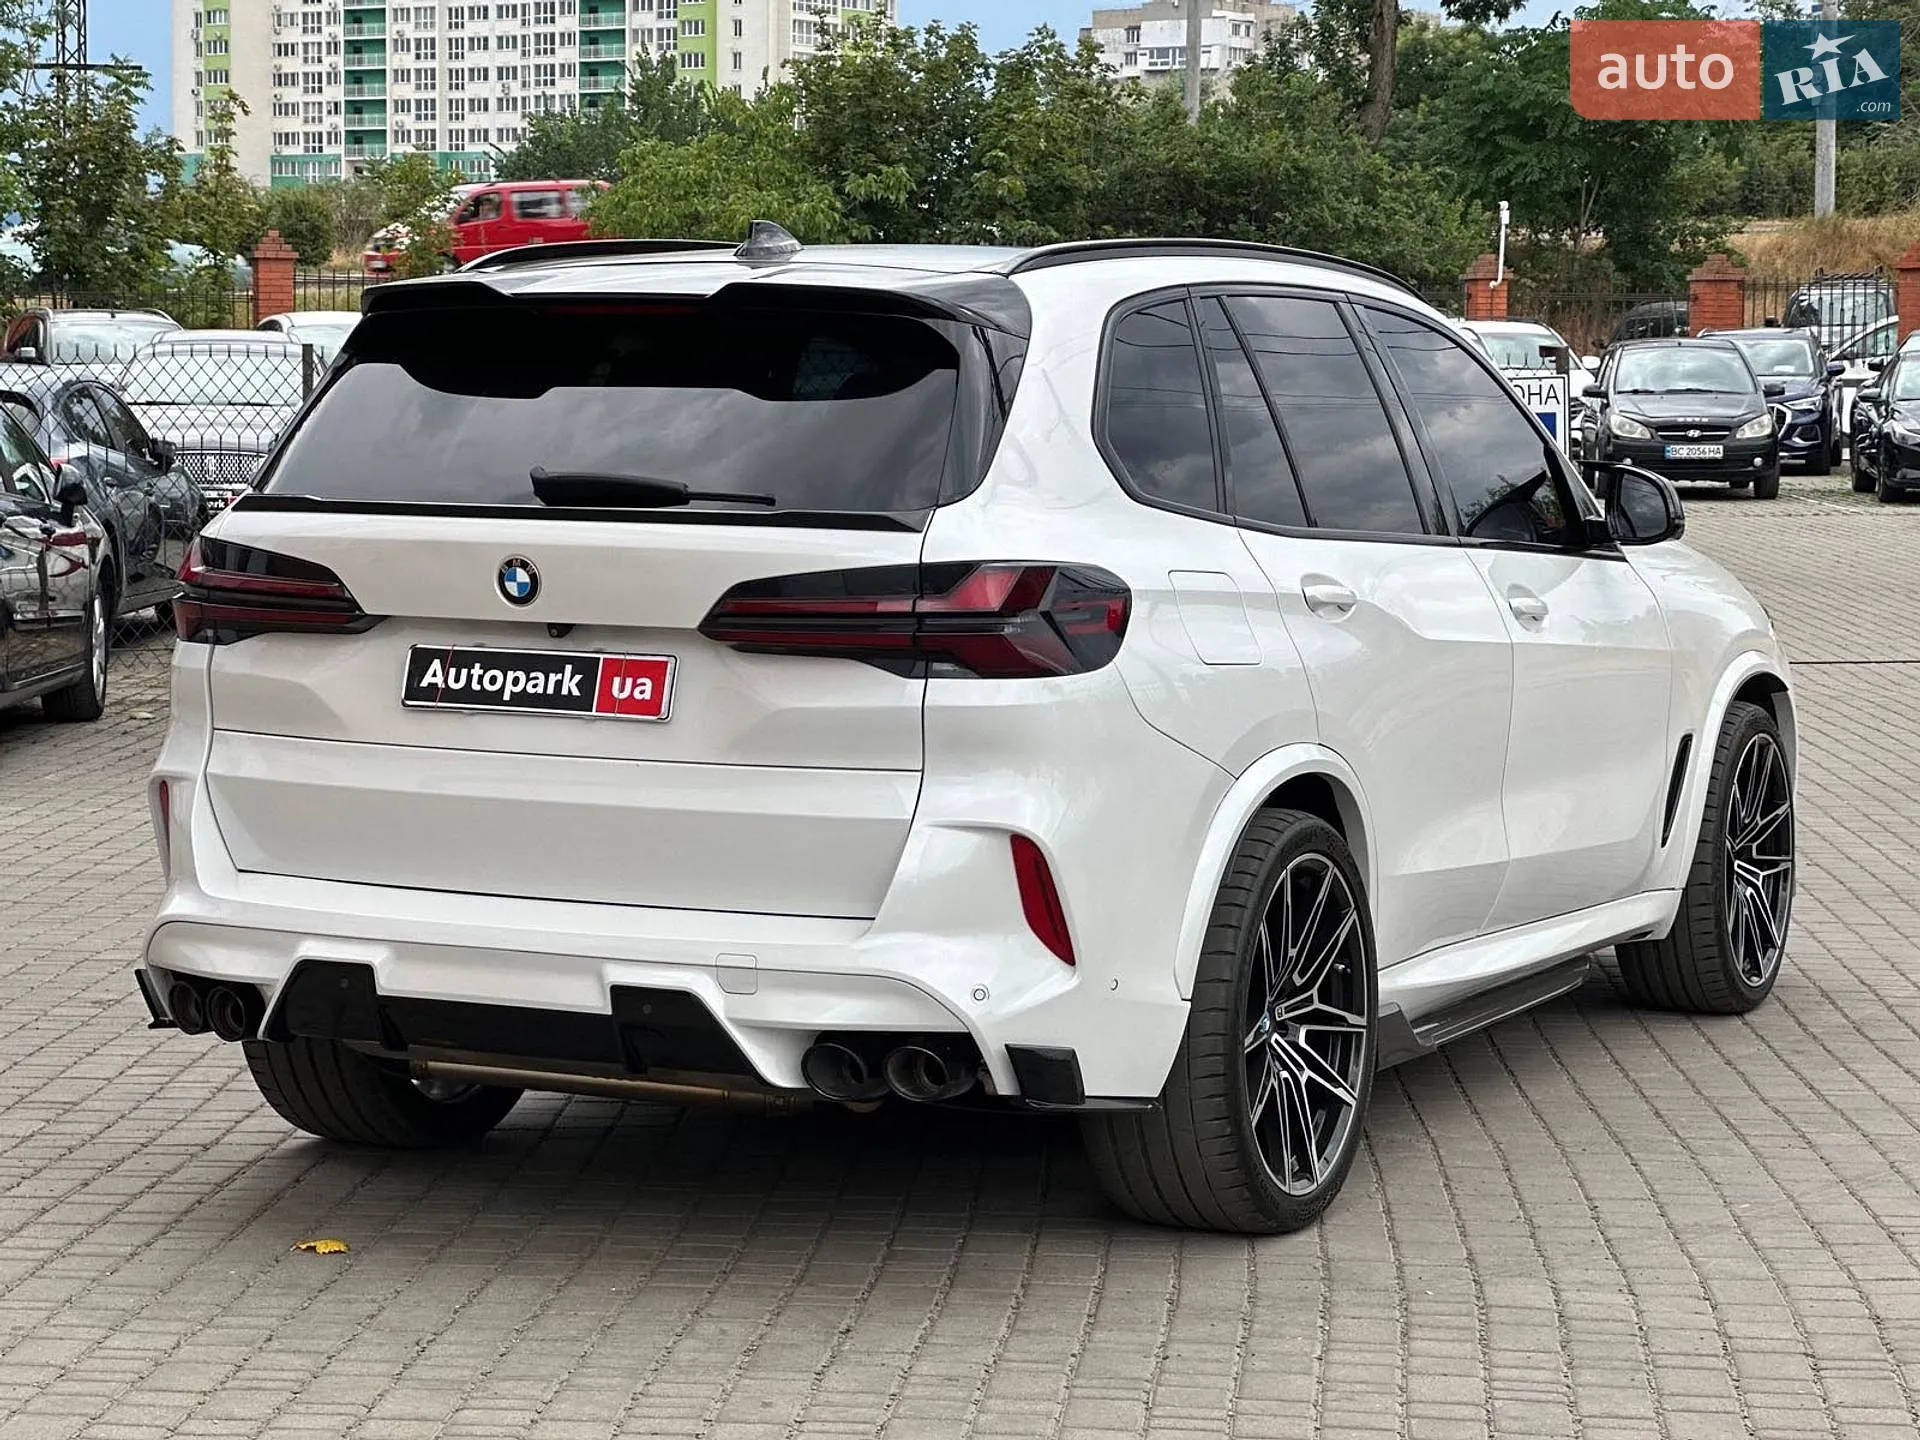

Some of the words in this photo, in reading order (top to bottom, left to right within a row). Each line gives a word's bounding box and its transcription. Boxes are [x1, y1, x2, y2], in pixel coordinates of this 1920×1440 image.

[1671, 446, 1685, 456] BC
[1708, 446, 1722, 456] HA
[419, 658, 585, 701] Autopark
[611, 675, 652, 701] ua
